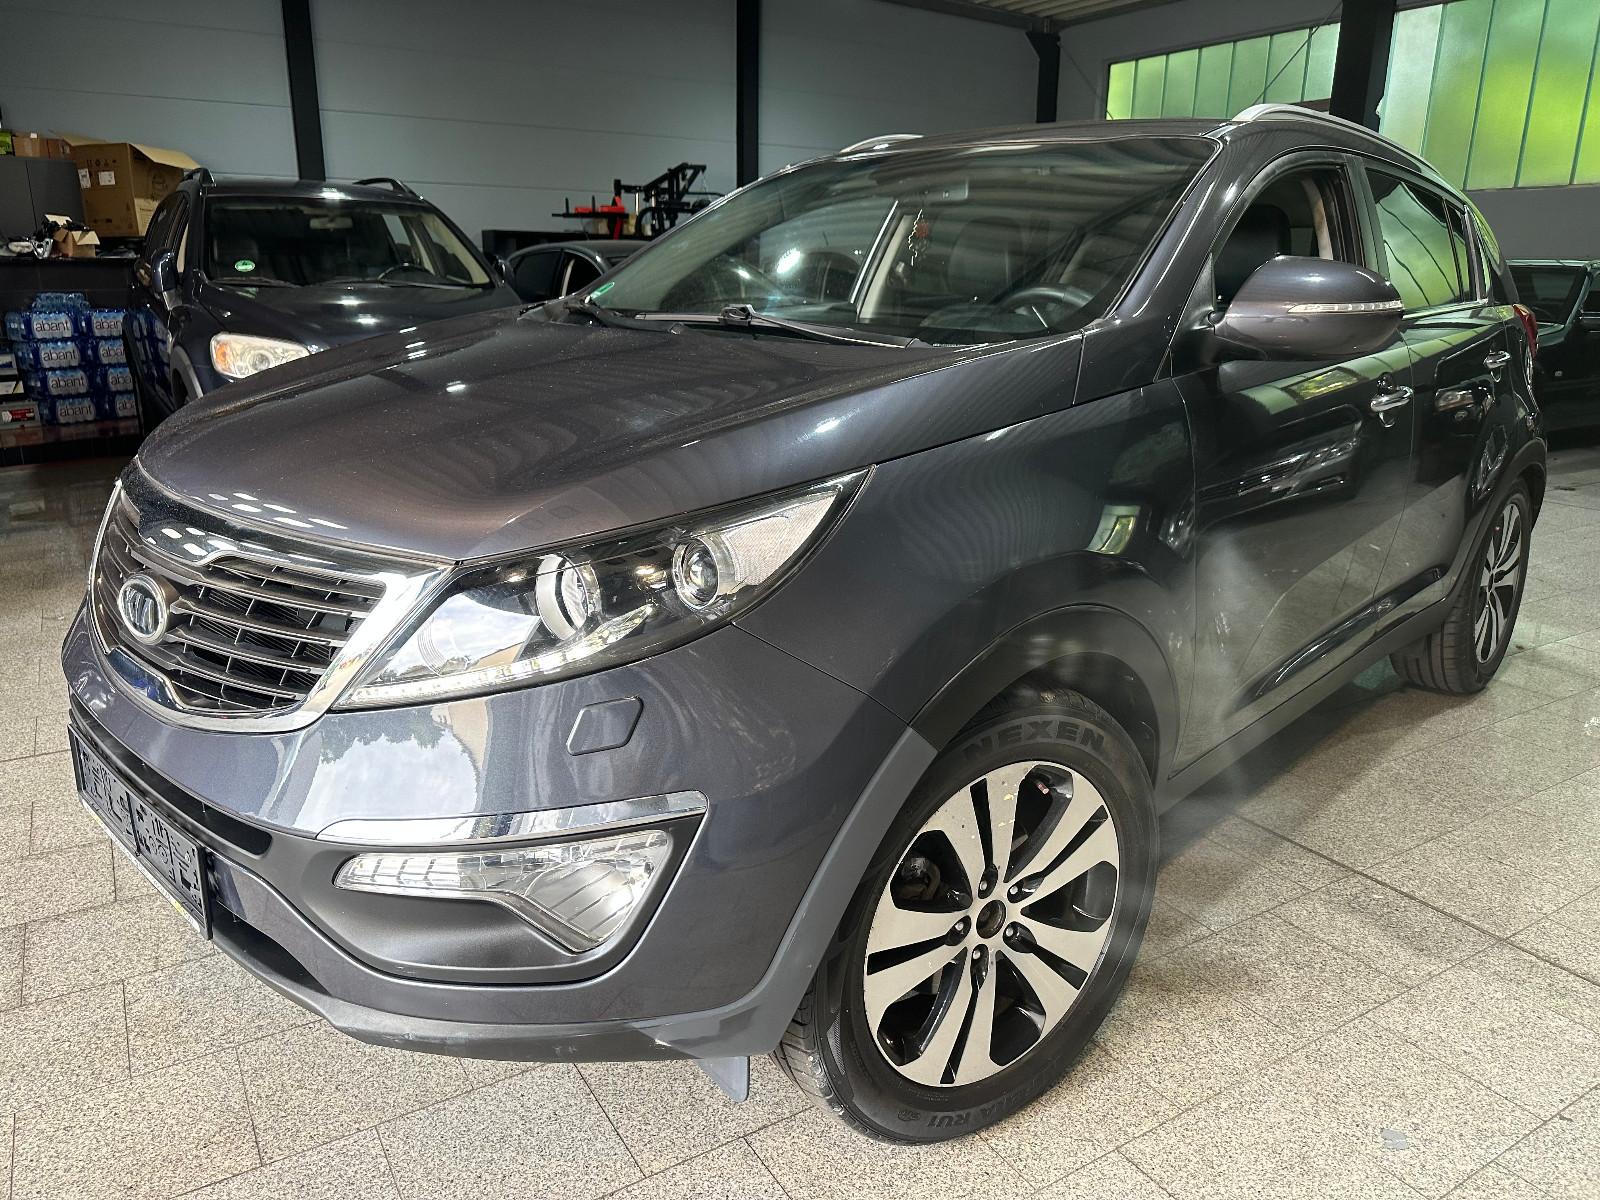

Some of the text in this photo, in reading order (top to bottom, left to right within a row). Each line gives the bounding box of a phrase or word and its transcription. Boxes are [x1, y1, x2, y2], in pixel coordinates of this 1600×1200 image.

[35, 319, 70, 333] abant
[43, 349, 77, 362] abant
[51, 375, 85, 389] abant
[59, 403, 92, 417] abant
[963, 720, 1104, 761] NEXEN
